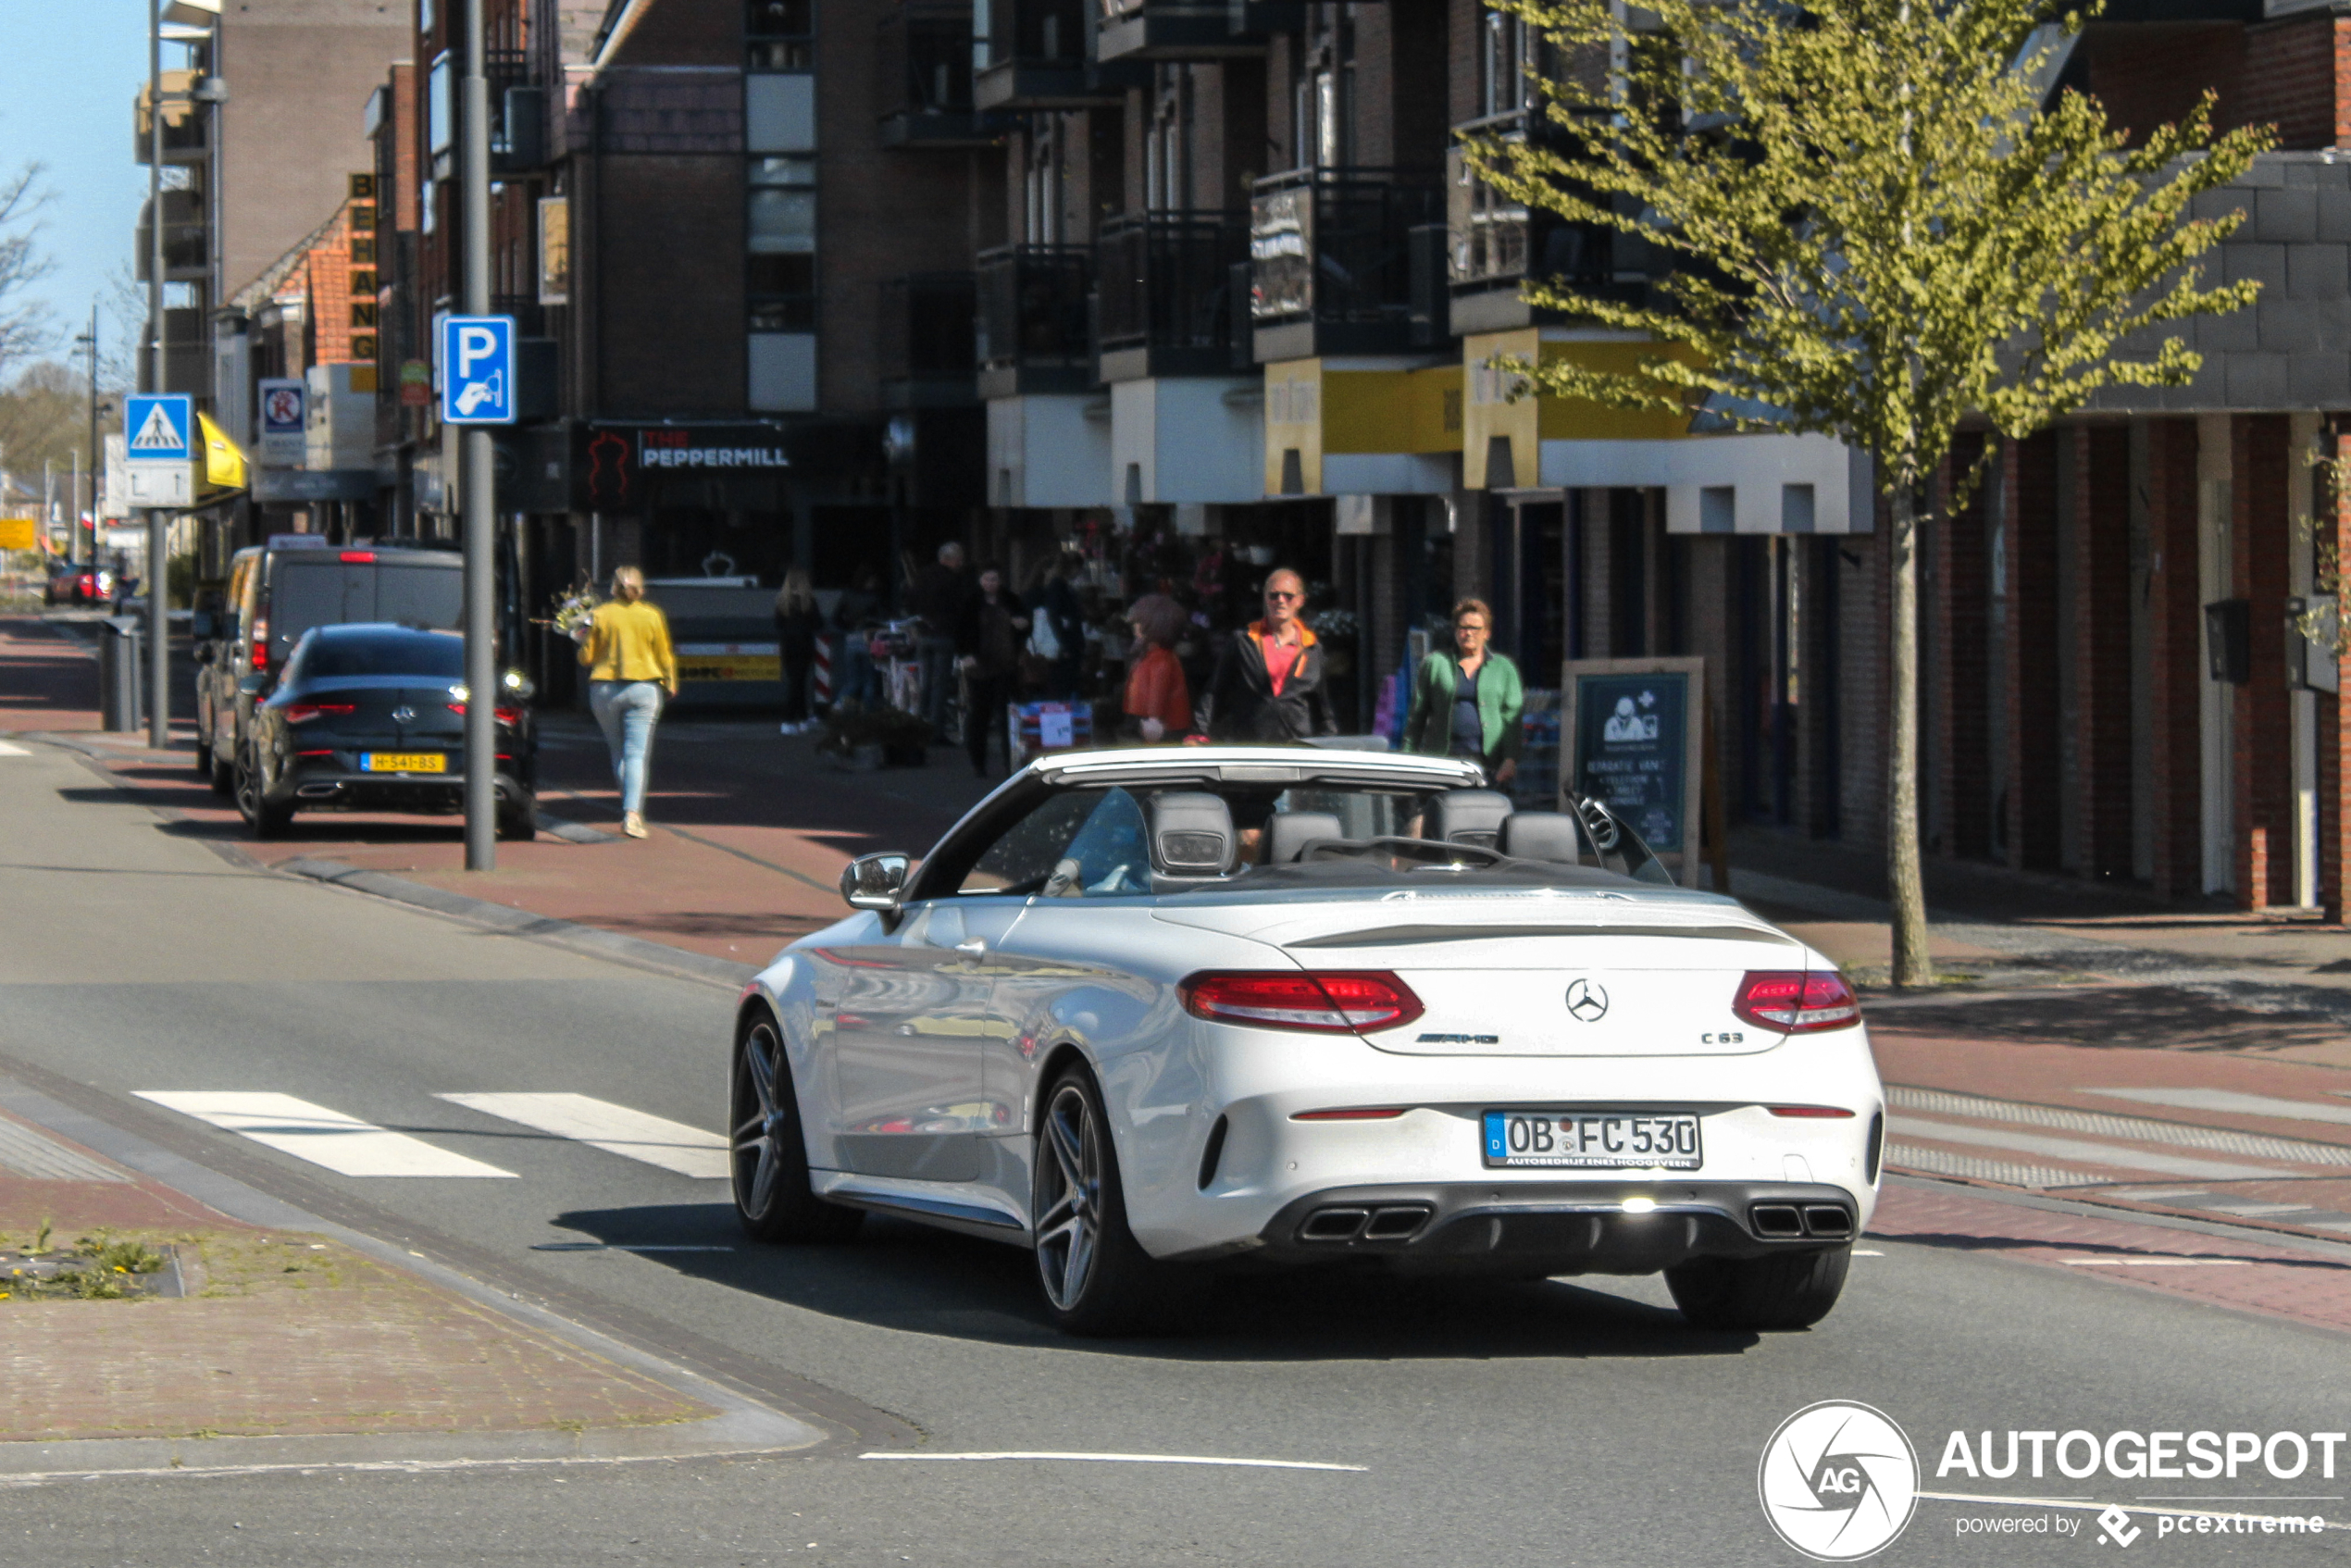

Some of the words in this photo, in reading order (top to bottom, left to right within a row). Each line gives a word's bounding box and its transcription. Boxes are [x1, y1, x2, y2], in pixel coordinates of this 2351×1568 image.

[352, 173, 374, 359] BEHANG
[459, 327, 497, 378] P
[645, 430, 689, 447] THE
[643, 448, 789, 467] PEPPERMILL
[1701, 1032, 1713, 1044] C
[1718, 1032, 1744, 1044] 63
[1507, 1116, 1554, 1153] OB
[1578, 1117, 1623, 1153] FC
[1631, 1118, 1696, 1155] 530
[1617, 1159, 1690, 1167] HOOGEVEEN
